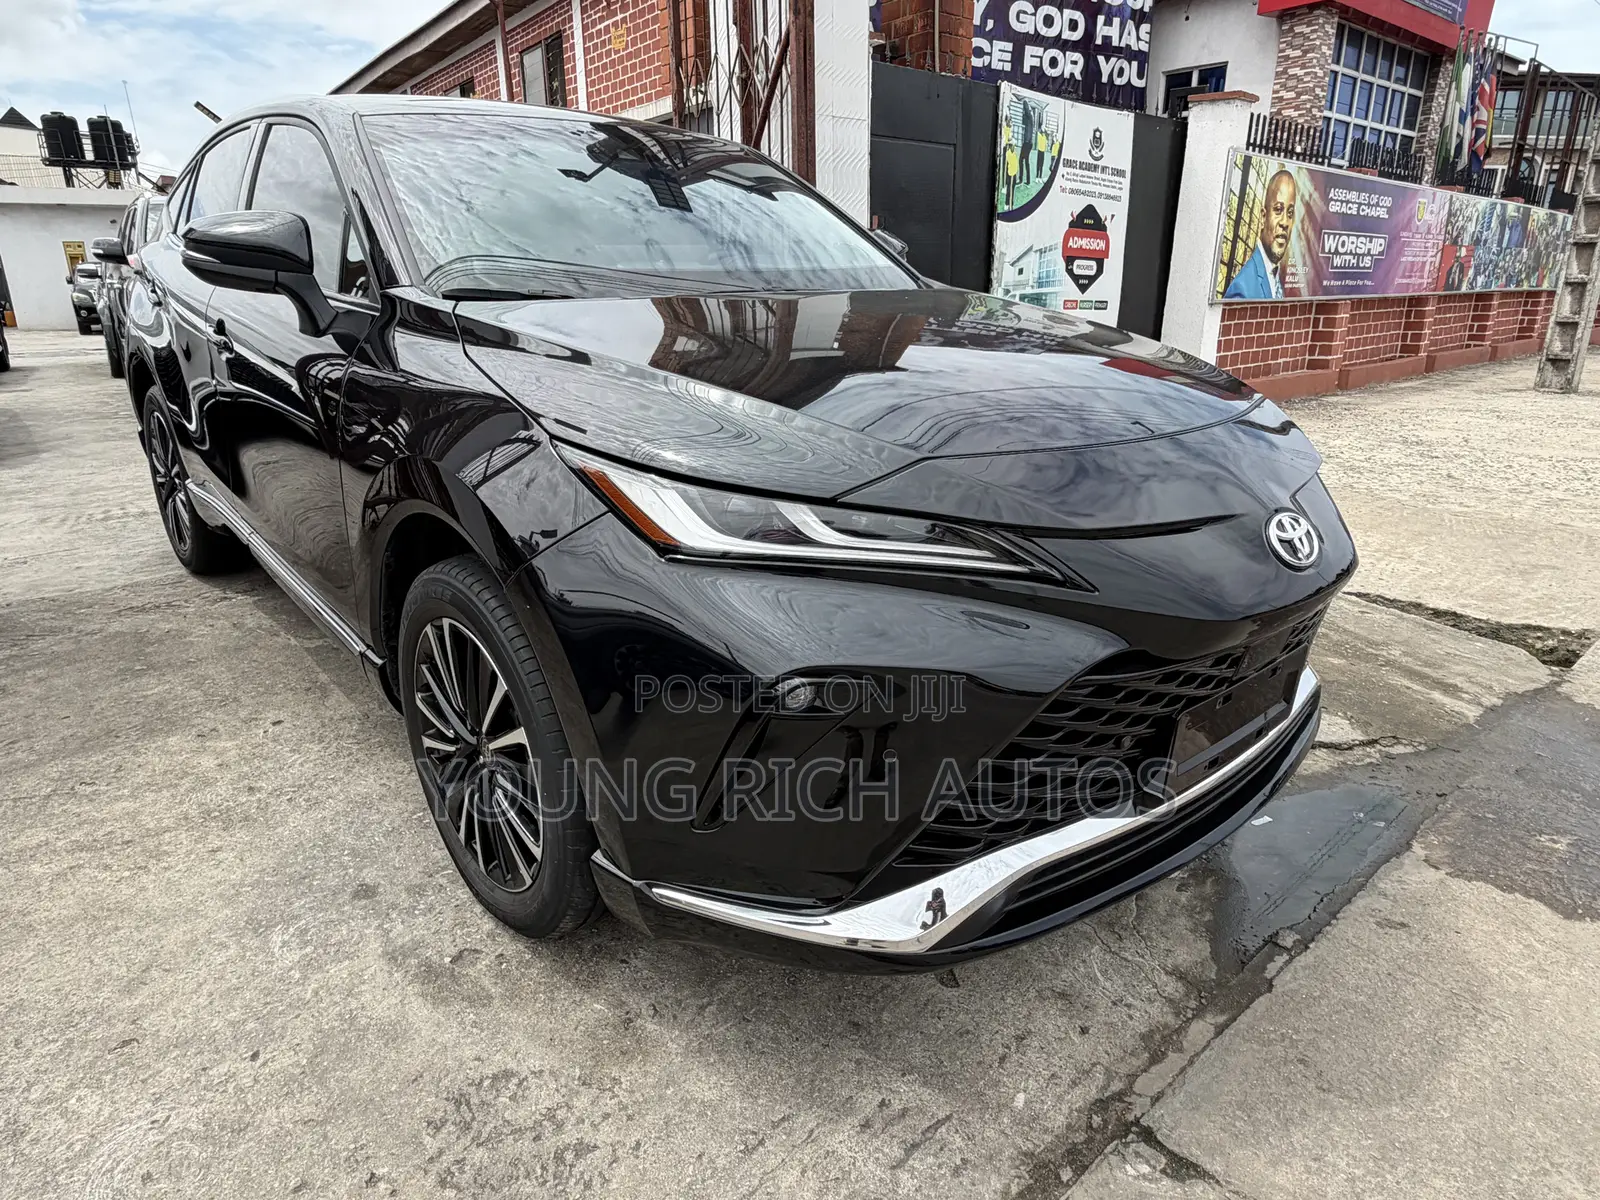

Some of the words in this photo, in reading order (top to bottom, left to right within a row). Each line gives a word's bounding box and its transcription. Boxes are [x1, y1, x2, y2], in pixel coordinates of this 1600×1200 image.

[1009, 1, 1085, 42] GOD
[1095, 15, 1151, 52] HAS
[1023, 45, 1085, 80] FOR
[1096, 55, 1148, 87] YOU
[1063, 158, 1078, 169] GRACE
[1079, 161, 1100, 173] ACADEMY
[1111, 167, 1126, 178] SCHOOL
[1329, 188, 1369, 204] ASSEMBLIES
[1370, 195, 1378, 206] OF
[1379, 197, 1393, 206] GOD
[1329, 201, 1358, 215] GRACE
[1360, 205, 1389, 218] CHAPEL
[1068, 237, 1106, 251] ADMISSION
[1324, 234, 1386, 255] WORSHIP
[1333, 255, 1357, 267] WITH
[1359, 256, 1372, 267] US
